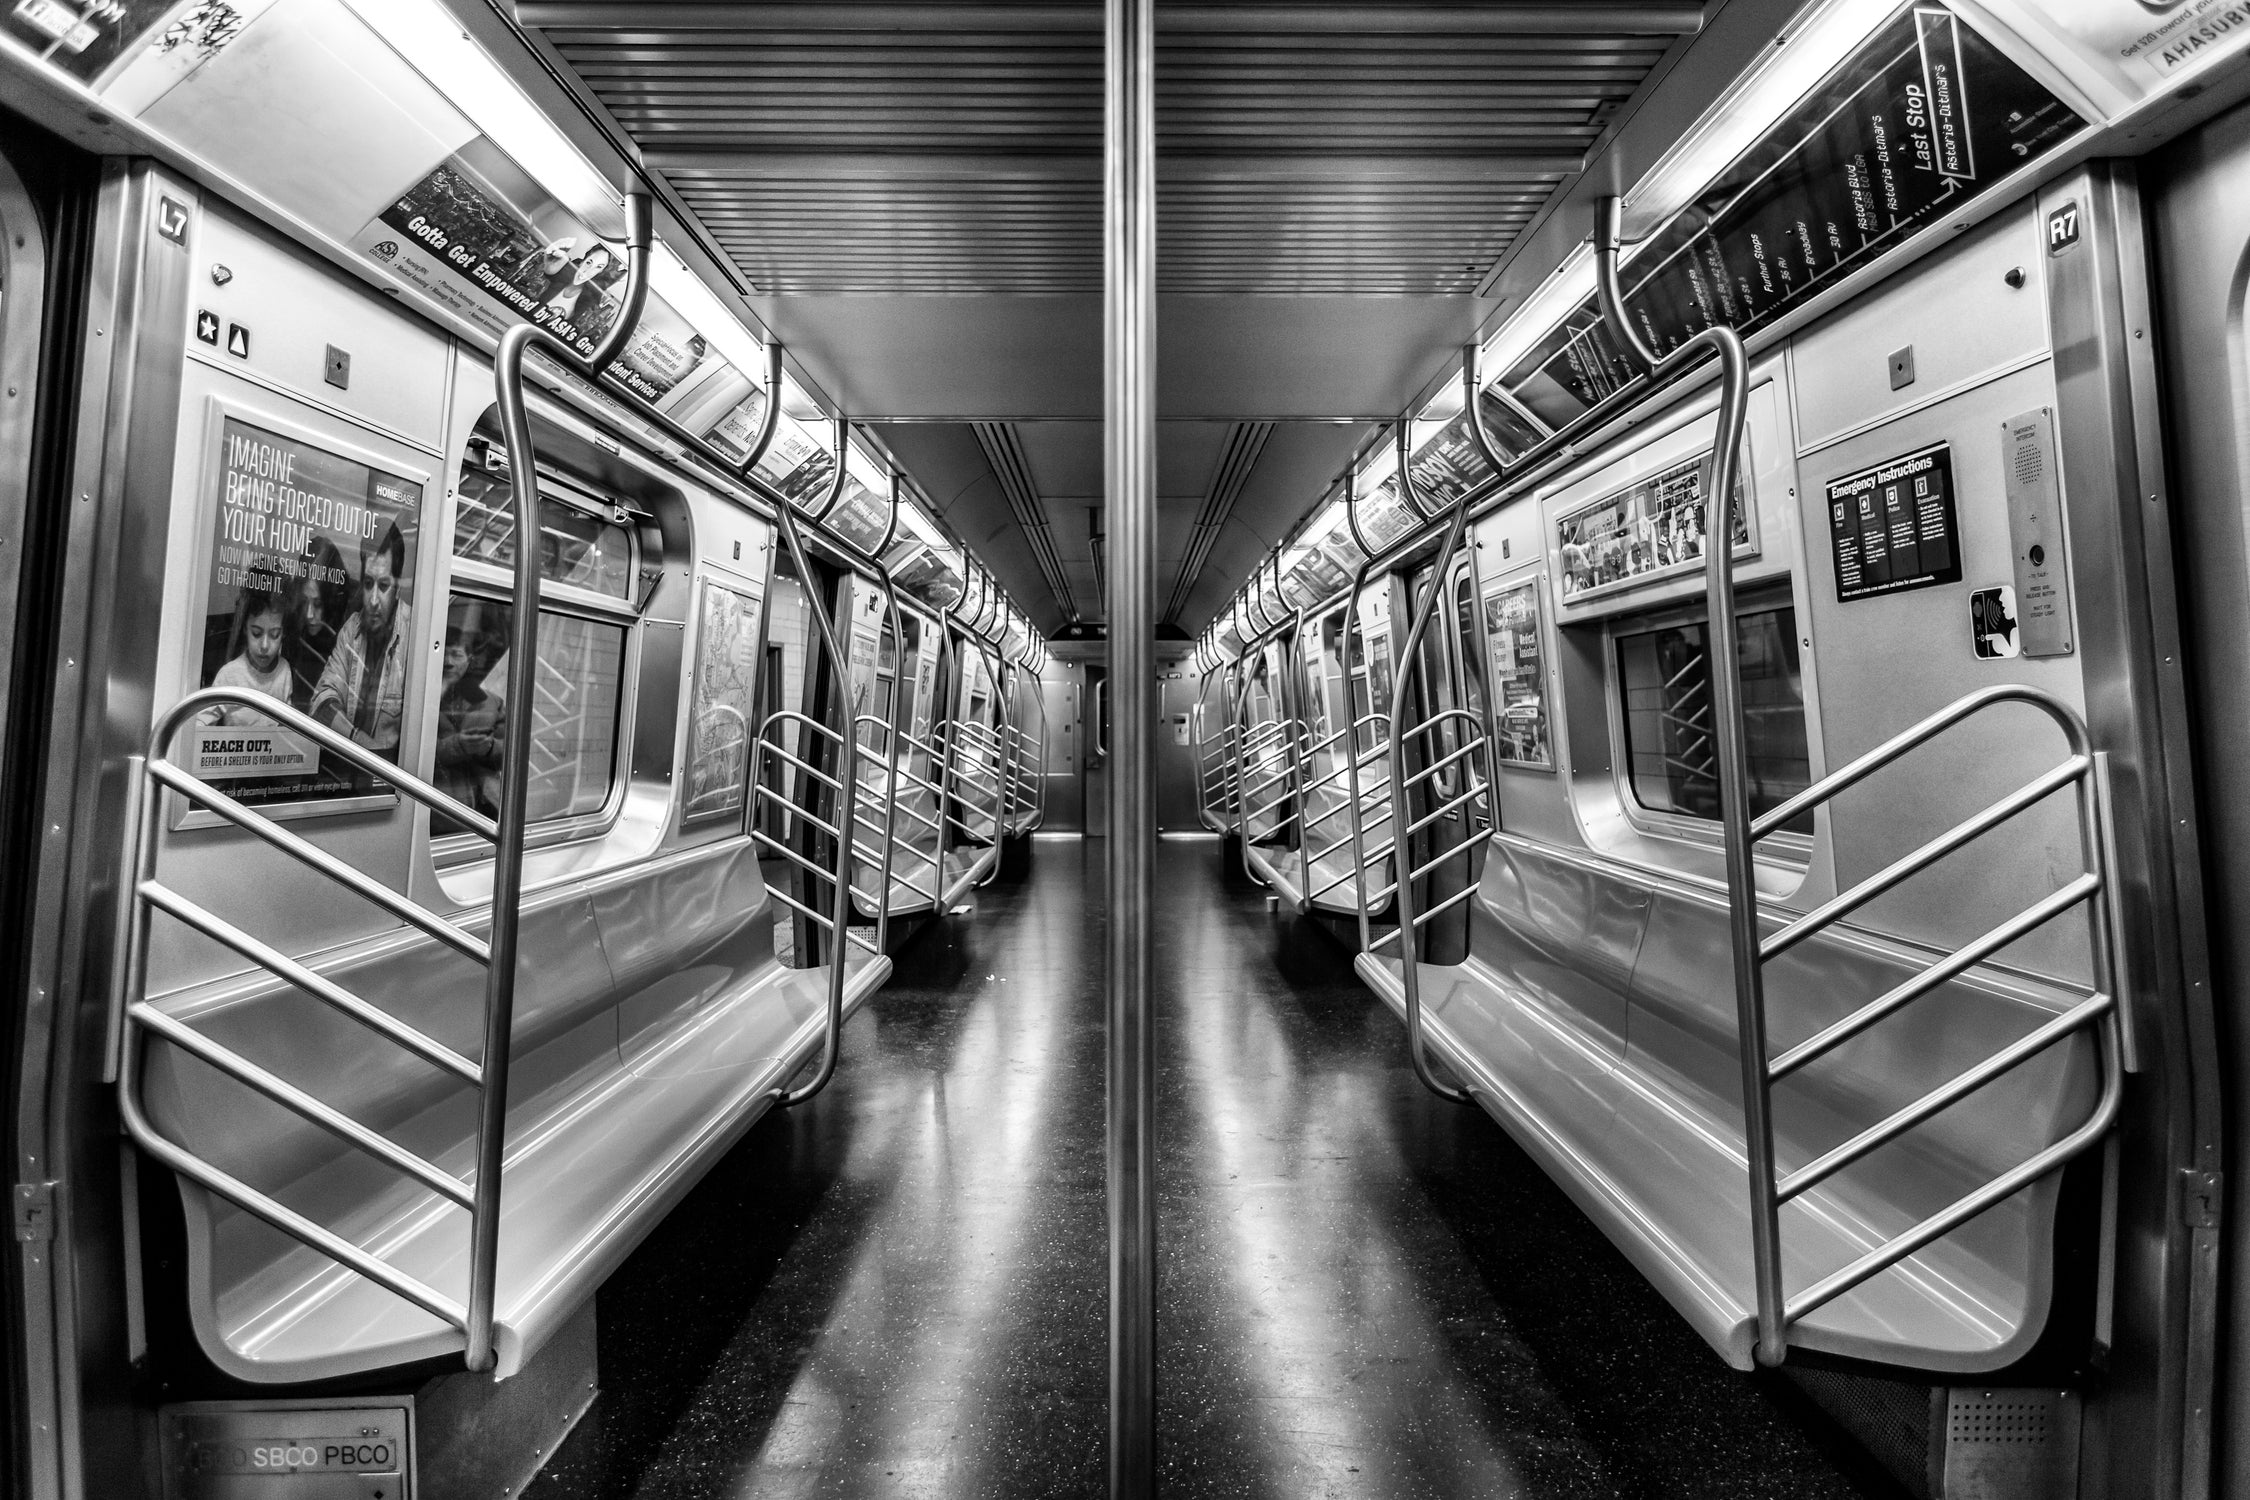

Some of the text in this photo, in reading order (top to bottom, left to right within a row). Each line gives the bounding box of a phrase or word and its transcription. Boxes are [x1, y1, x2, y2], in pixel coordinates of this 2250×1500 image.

[2121, 44, 2140, 57] Get
[2156, 9, 2193, 36] toward
[1906, 84, 1932, 171] Last Stop
[1935, 64, 1958, 170] Astoria-Ditmars
[1872, 115, 1898, 210] Astoria-Ditmars
[1845, 164, 1868, 230] Astoria Blvd
[159, 202, 187, 236] L7
[2050, 209, 2077, 244] R7
[368, 248, 391, 263] COLLEGE
[374, 240, 399, 259] ASA
[1751, 233, 1774, 293] Further Stops
[1797, 221, 1816, 265] Broadway
[407, 216, 449, 250] Gotta
[448, 245, 476, 268] Get
[472, 262, 540, 313] Empowered
[533, 305, 551, 325] by
[548, 315, 578, 342] ASA's
[575, 336, 596, 355] Gre
[628, 370, 658, 398] Services
[229, 434, 296, 485] IMAGINE
[1831, 457, 1933, 499] Emergency Instructions
[226, 470, 380, 539] BEING FORCED OUT OF
[376, 484, 415, 507] HOMEBASE
[223, 505, 315, 558] YOUR HOME.
[218, 566, 283, 594] GO THROUGH IT.
[219, 545, 346, 585] NOW IMAGINE SEEING YOUR KIDS
[201, 740, 273, 755] REACH OUT,
[201, 756, 222, 767] BEFORE
[227, 755, 251, 766] SHELTER
[252, 755, 258, 764] IS
[259, 754, 273, 765] YOUR
[273, 754, 286, 764] ONLY
[253, 1447, 318, 1467] SBCO
[325, 1445, 390, 1465] PBCO
